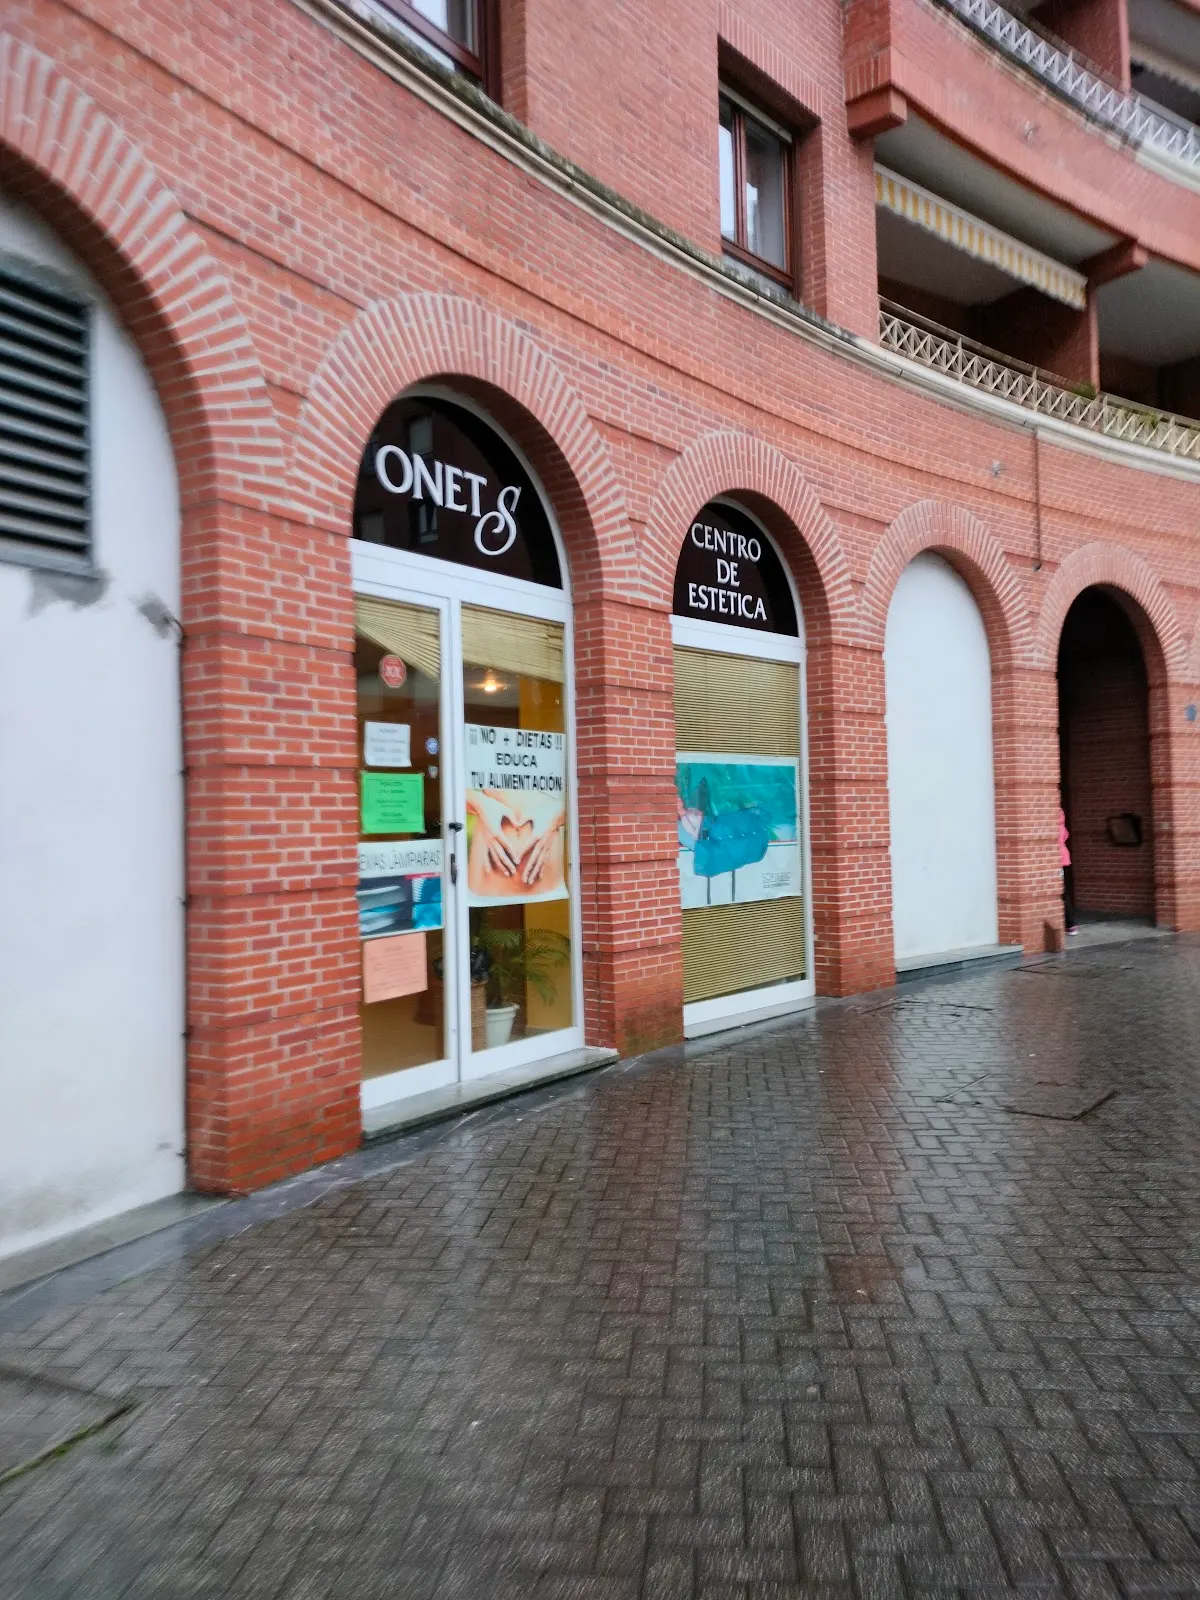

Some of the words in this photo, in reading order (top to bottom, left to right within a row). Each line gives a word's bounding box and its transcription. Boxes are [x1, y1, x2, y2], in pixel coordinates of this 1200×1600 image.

[691, 522, 762, 563] CENTRO
[717, 558, 740, 587] DE
[688, 582, 767, 621] ESTETICA
[481, 727, 497, 745] NO
[516, 731, 552, 750] DIETAS
[496, 752, 538, 768] EDUCA
[471, 771, 485, 788] TU
